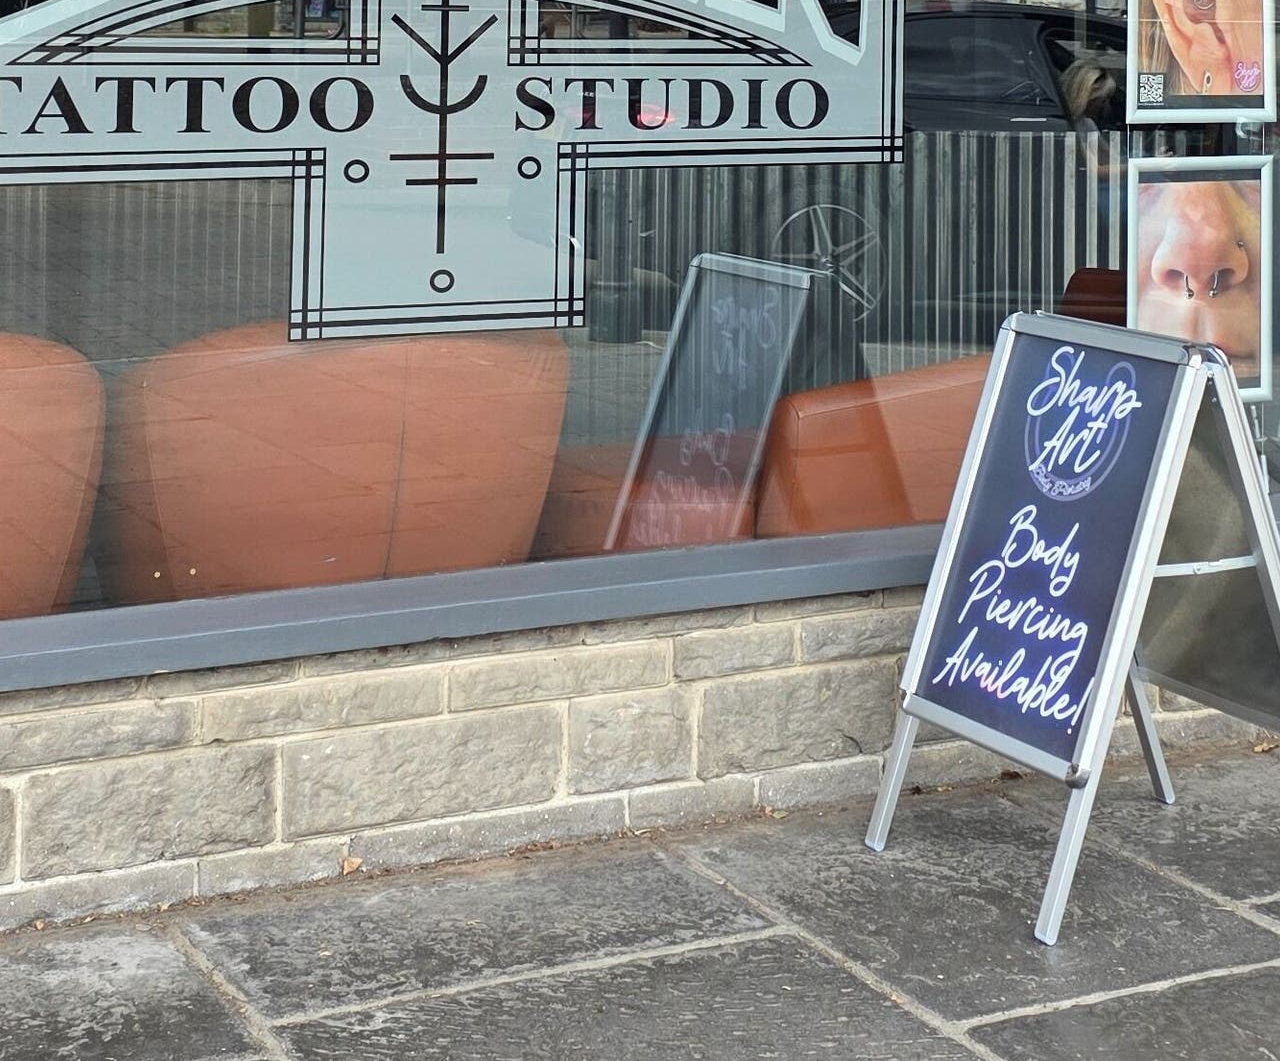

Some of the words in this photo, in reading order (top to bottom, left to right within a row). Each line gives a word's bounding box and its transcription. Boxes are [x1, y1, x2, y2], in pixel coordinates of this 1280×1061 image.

[514, 76, 830, 131] STUDIO
[1027, 346, 1143, 444] Sharp
[1029, 406, 1108, 473] Art
[1001, 504, 1080, 597] Body
[958, 559, 1089, 679] Piercing
[932, 626, 1095, 735] Available!
